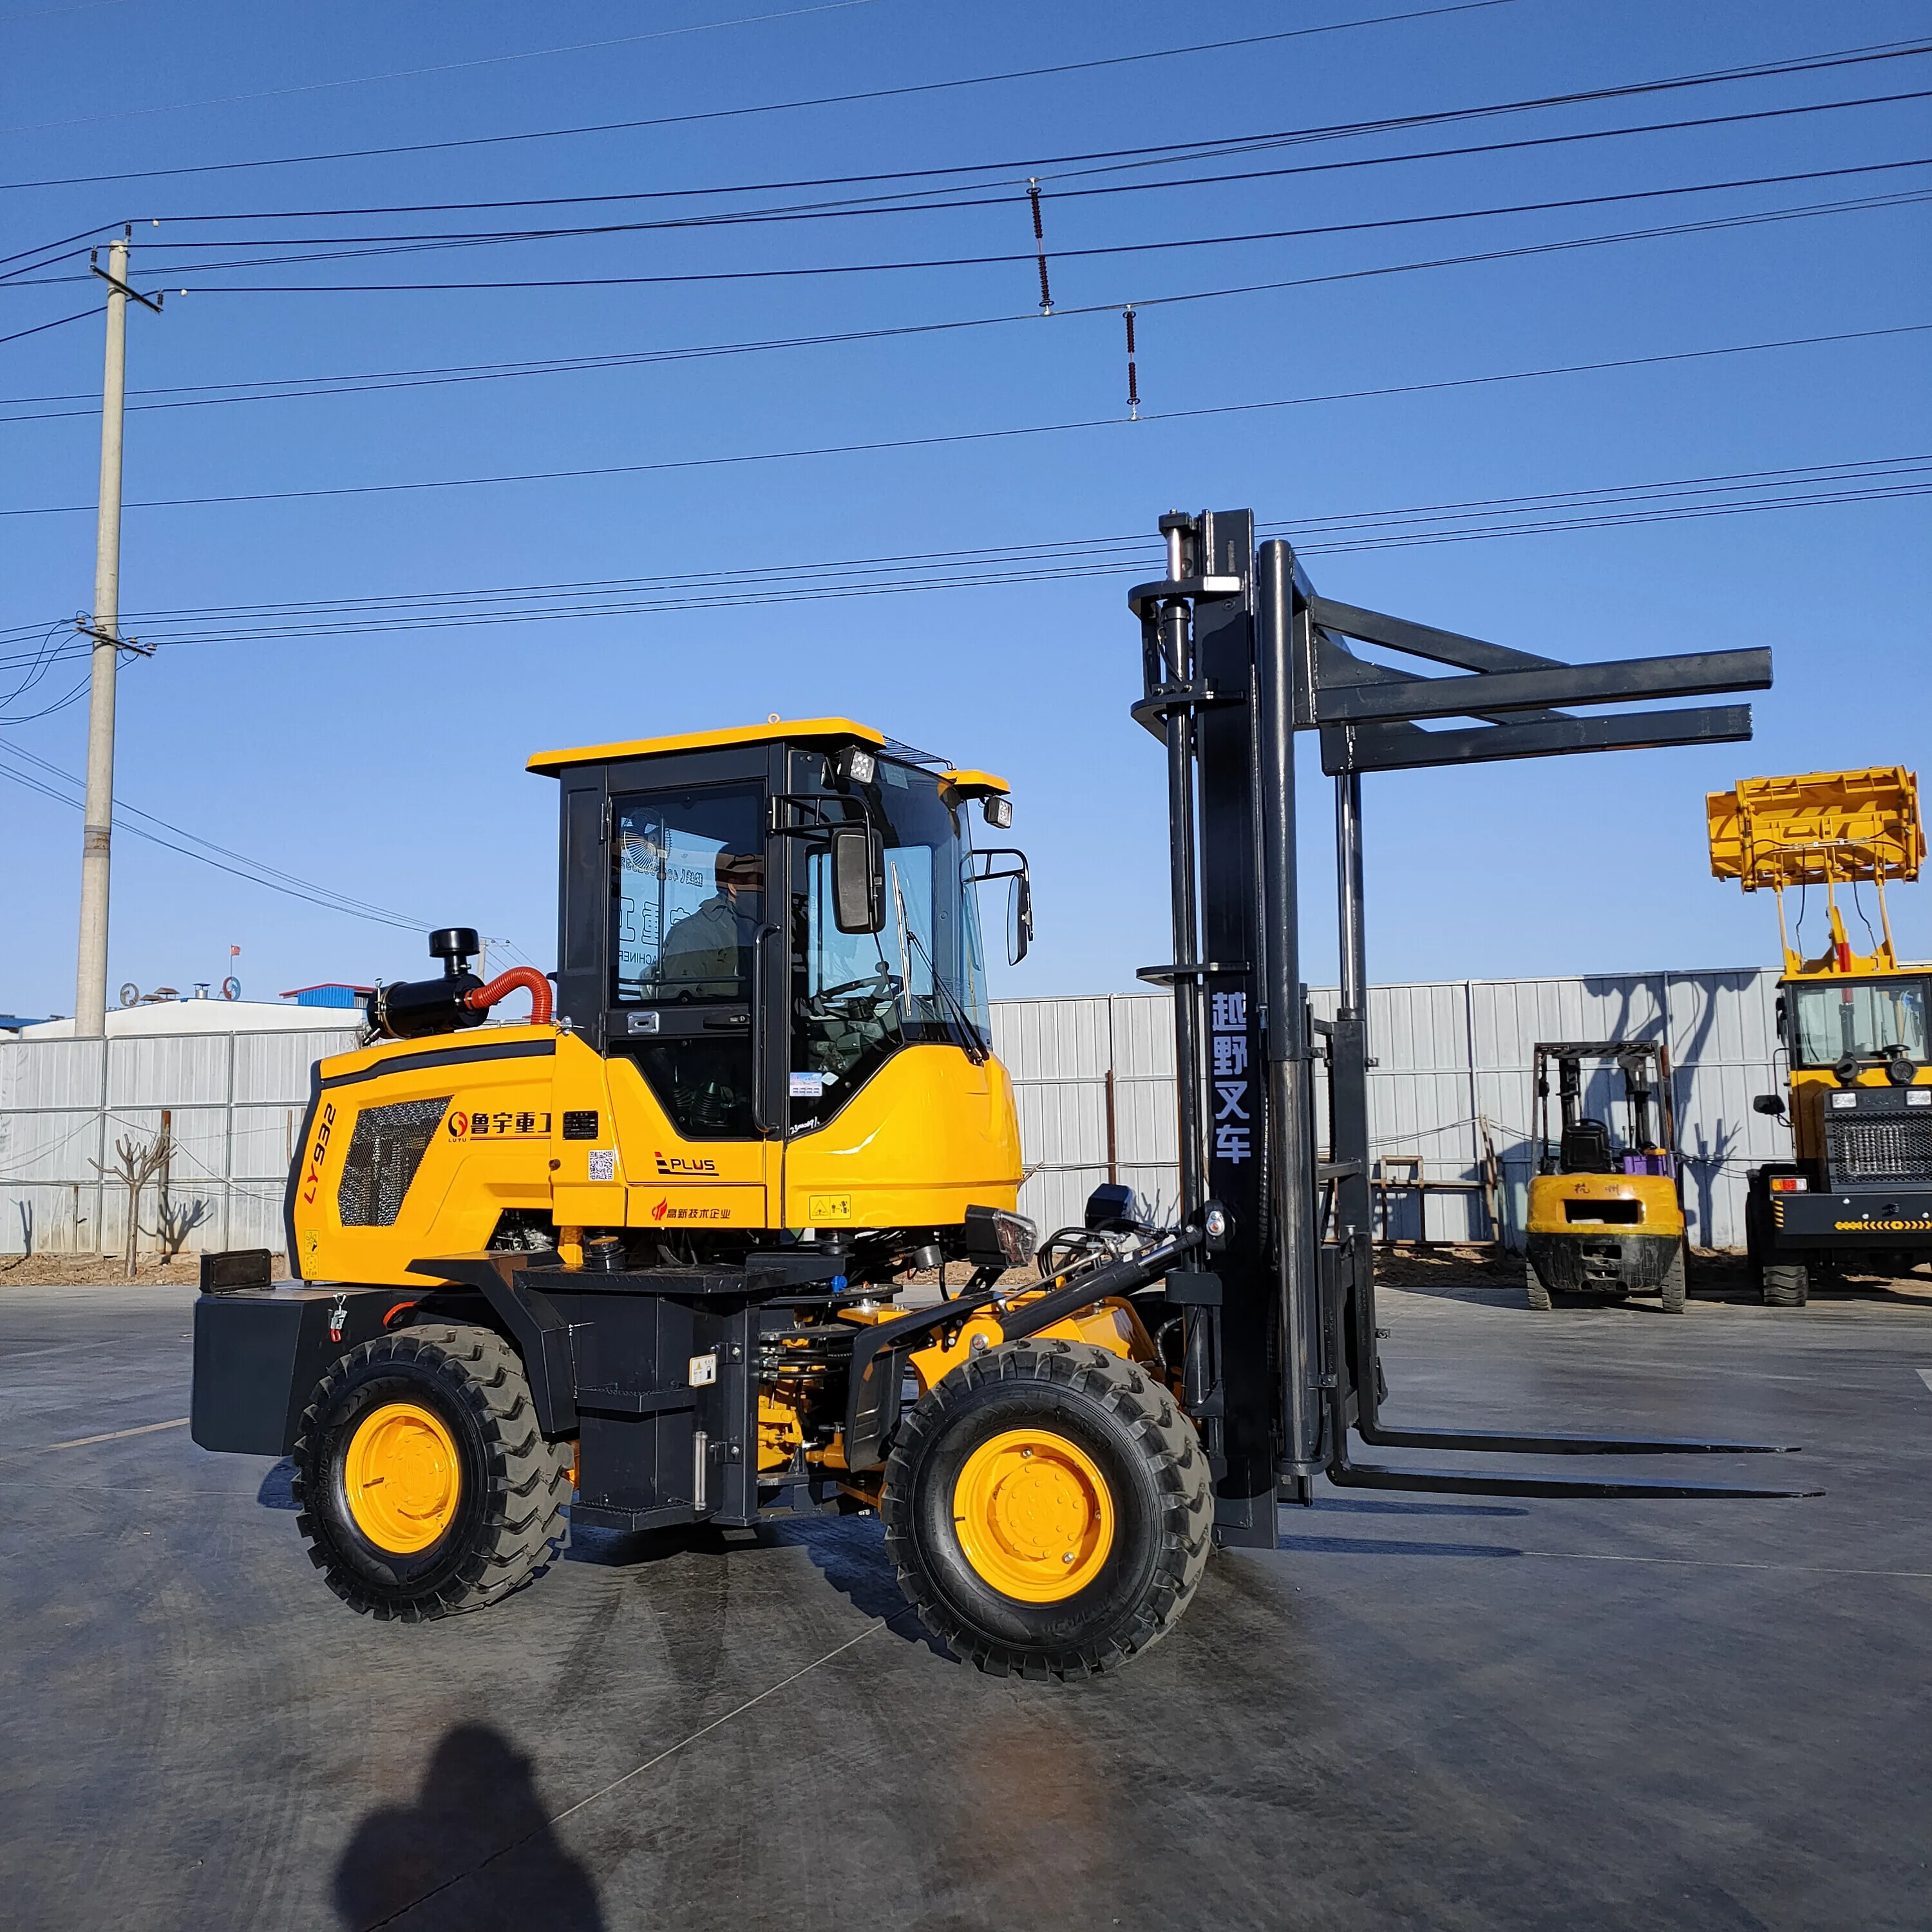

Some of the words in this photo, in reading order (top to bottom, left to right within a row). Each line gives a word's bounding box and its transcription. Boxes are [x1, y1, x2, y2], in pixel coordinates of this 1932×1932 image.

[1212, 992, 1251, 1164] 越野叉车
[303, 1103, 337, 1205] LY932
[670, 1159, 715, 1171] PLUS
[667, 1208, 731, 1219] 高新技术企业
